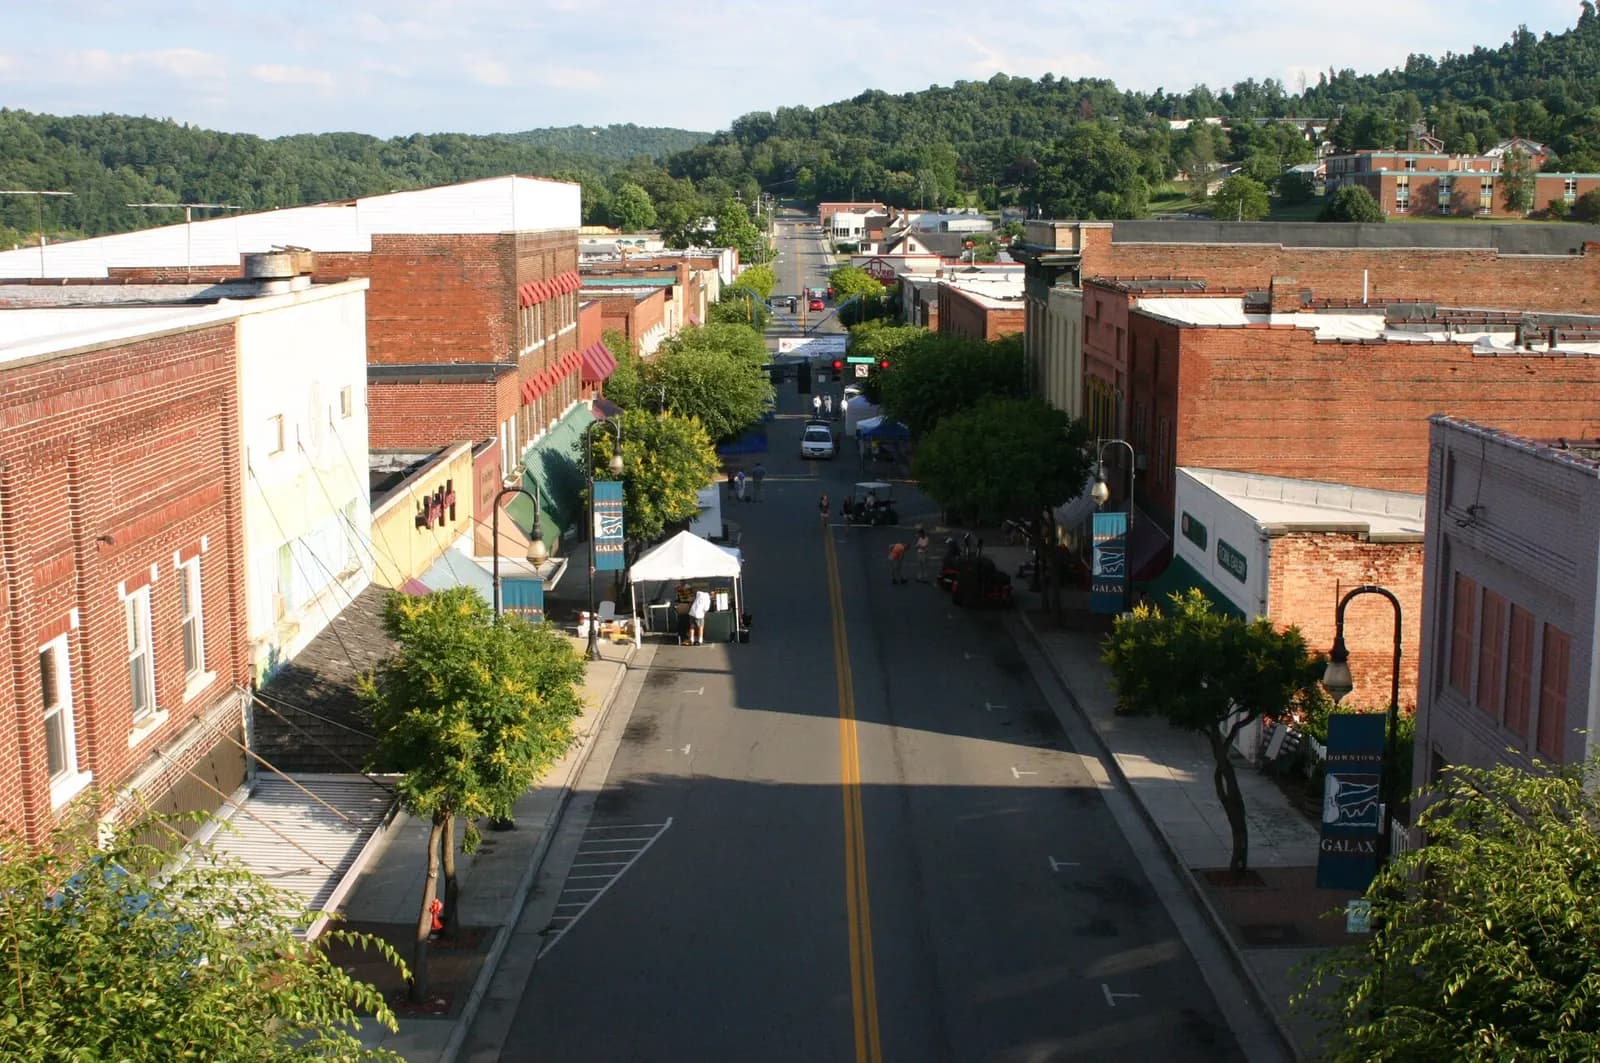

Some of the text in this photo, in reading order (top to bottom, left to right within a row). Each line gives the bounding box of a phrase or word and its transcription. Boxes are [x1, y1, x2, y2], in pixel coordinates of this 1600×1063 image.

[595, 544, 624, 552] GALAX
[1091, 584, 1124, 592] GALAX
[1321, 839, 1376, 853] GALAX
